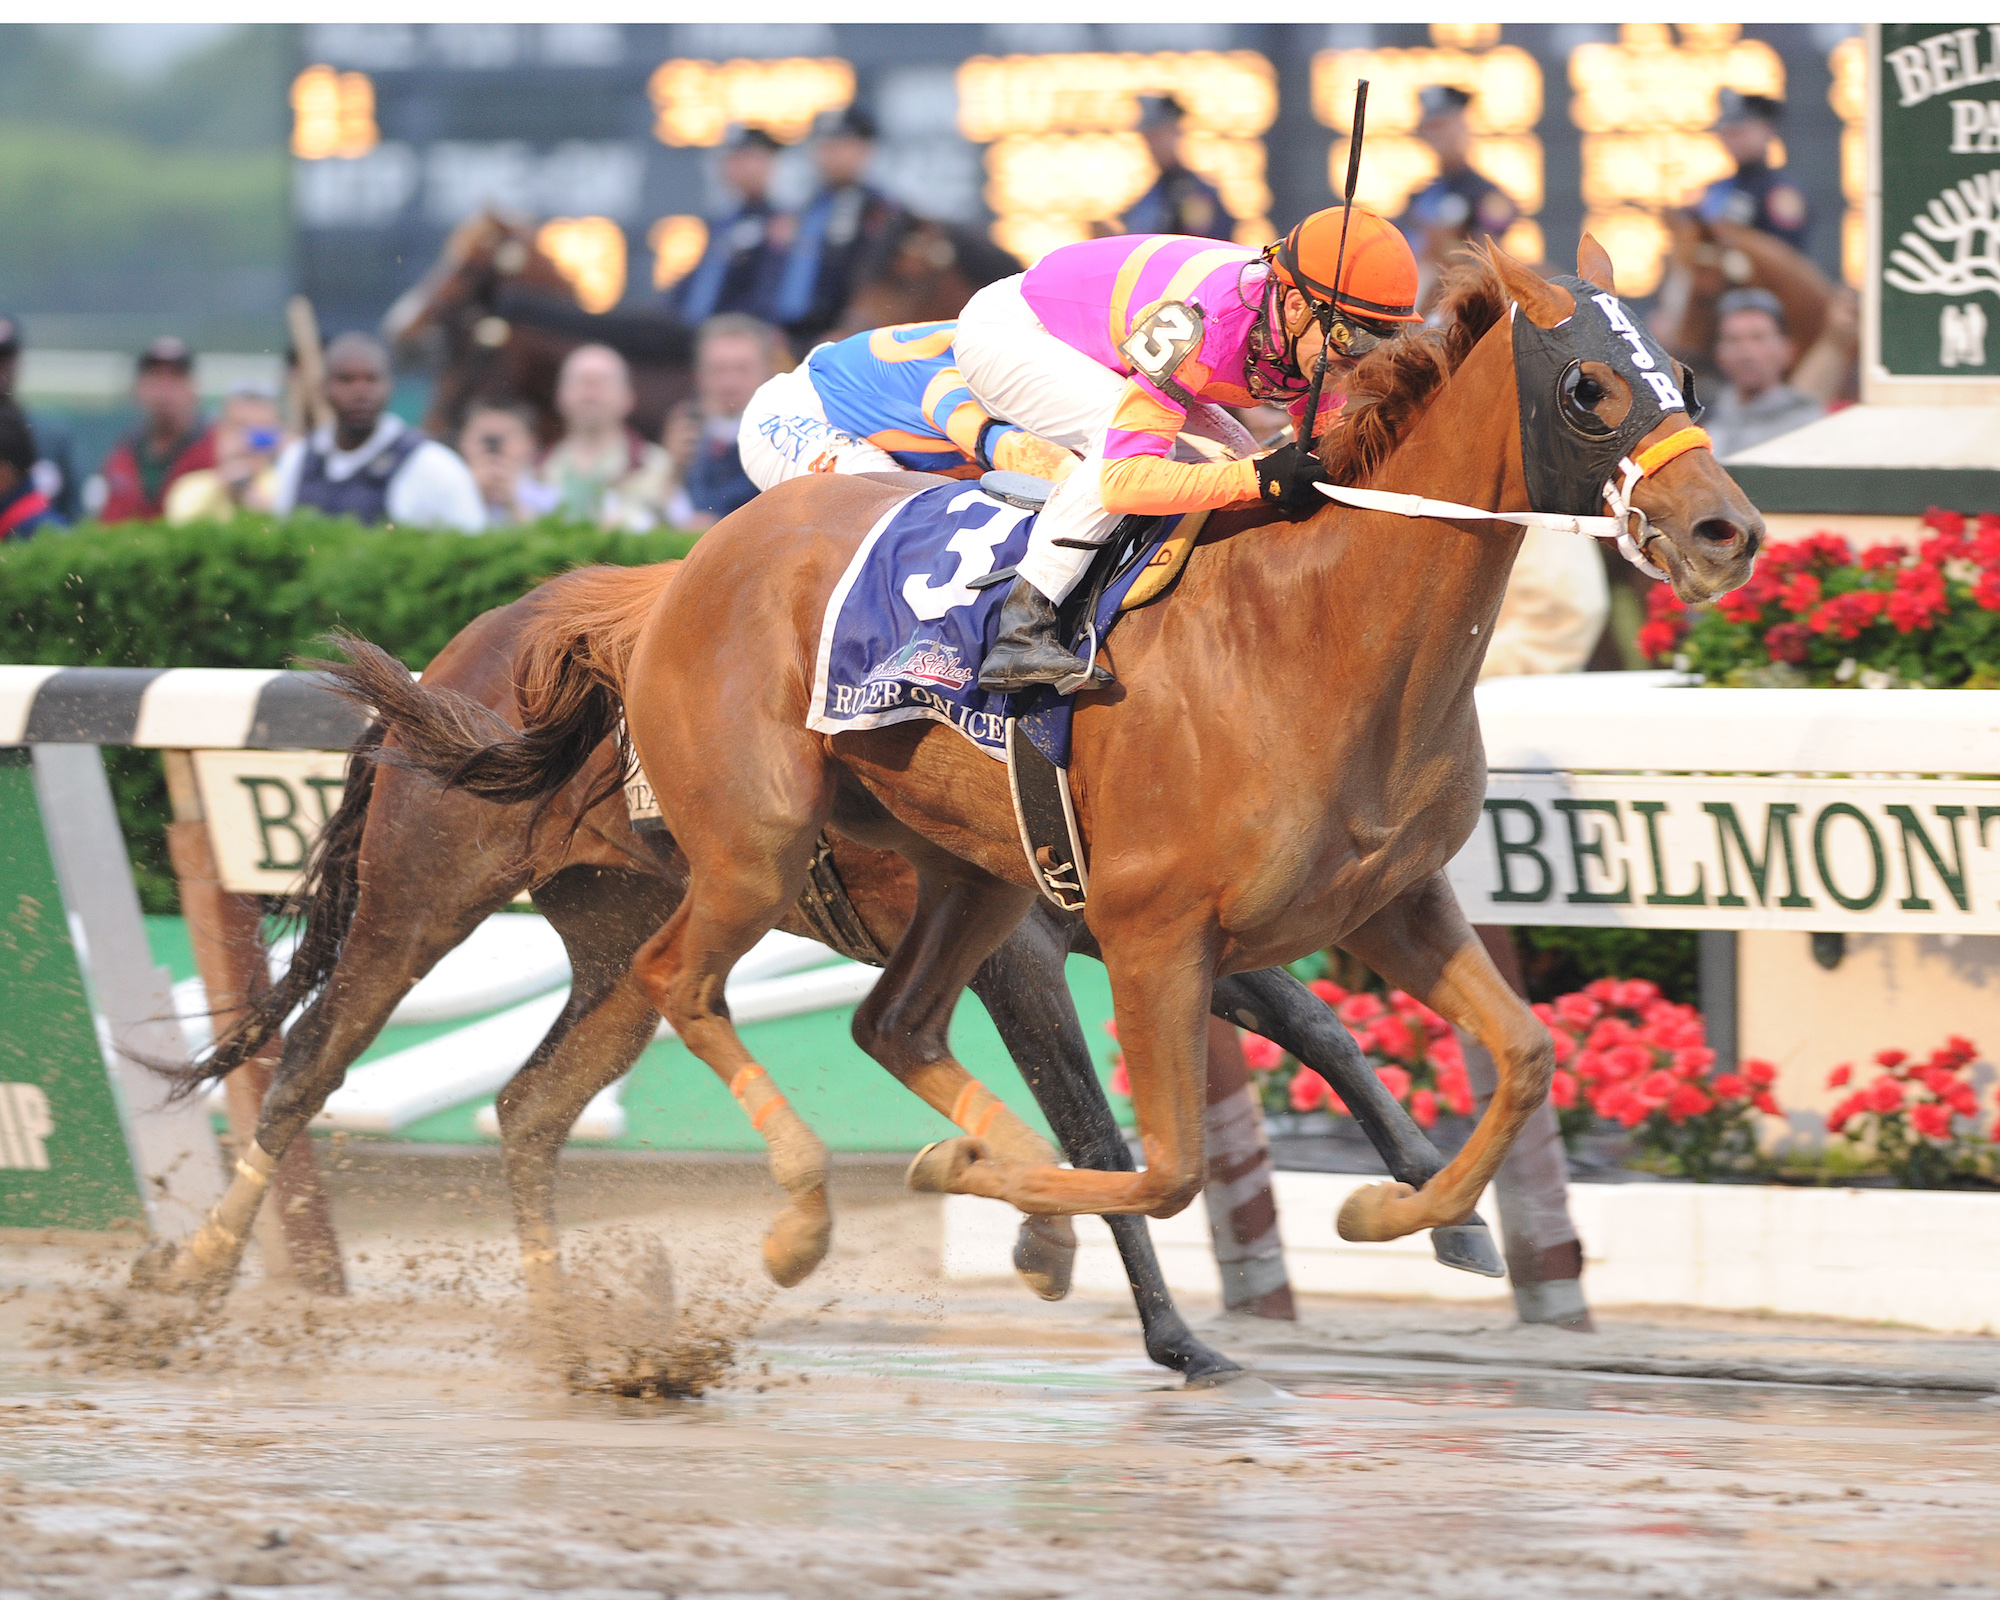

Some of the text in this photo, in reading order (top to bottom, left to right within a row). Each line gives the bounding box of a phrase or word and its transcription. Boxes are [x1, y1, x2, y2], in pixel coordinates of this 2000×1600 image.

[1885, 24, 2000, 107] BEL
[1131, 307, 1194, 371] 3
[1591, 292, 1684, 410] KJB
[903, 489, 1035, 621] 3
[914, 651, 974, 682] Stakes
[911, 686, 955, 716] ON
[957, 705, 1006, 743] ICE
